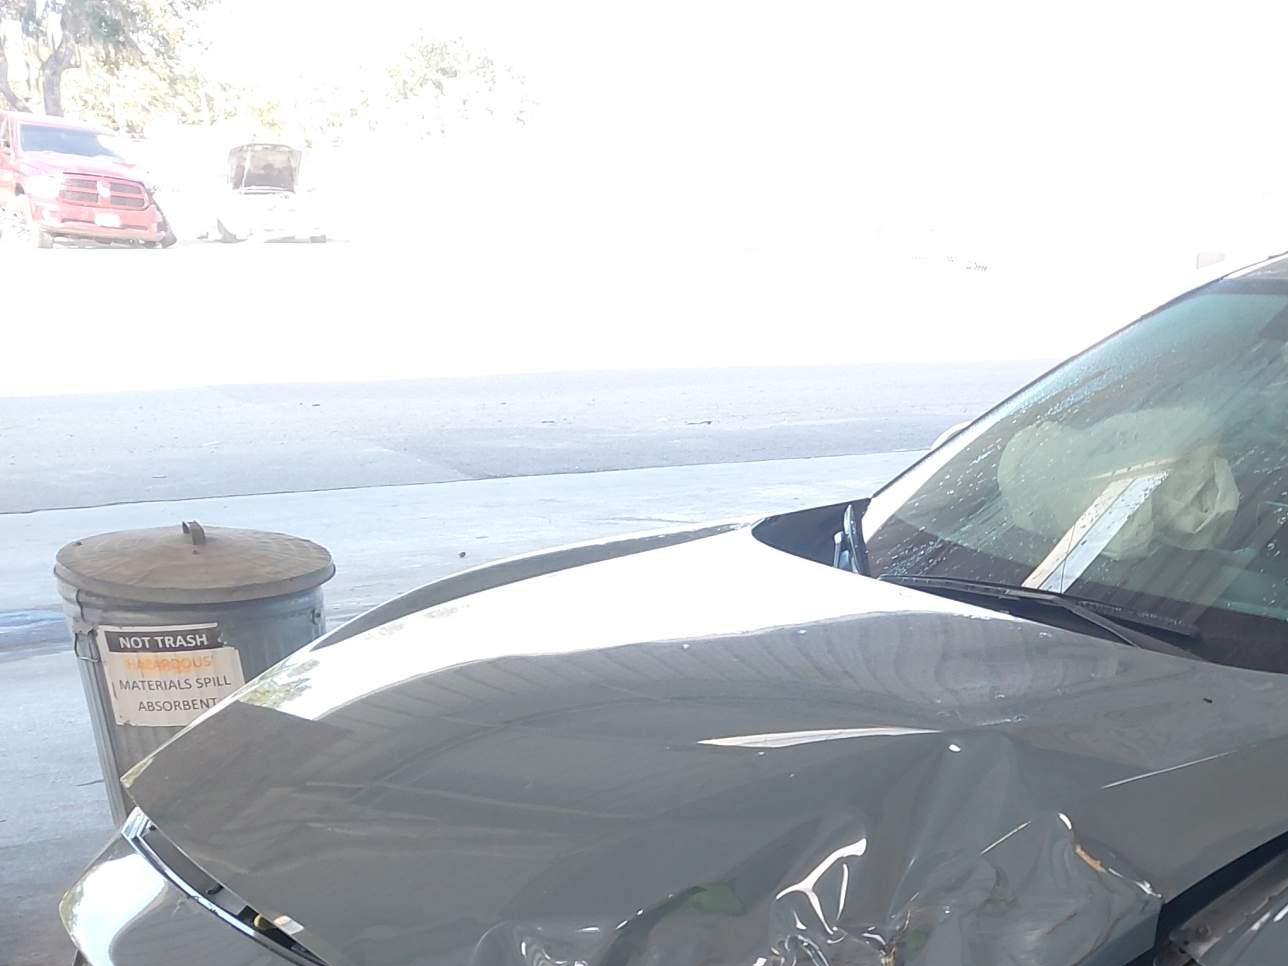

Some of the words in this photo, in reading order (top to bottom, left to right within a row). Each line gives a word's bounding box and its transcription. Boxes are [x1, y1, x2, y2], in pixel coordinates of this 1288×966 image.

[120, 637, 151, 649] NOT
[154, 633, 209, 648] TRASH
[119, 678, 193, 691] MATERIALS
[195, 675, 232, 690] SPILL
[138, 697, 217, 712] ABSORBENT
